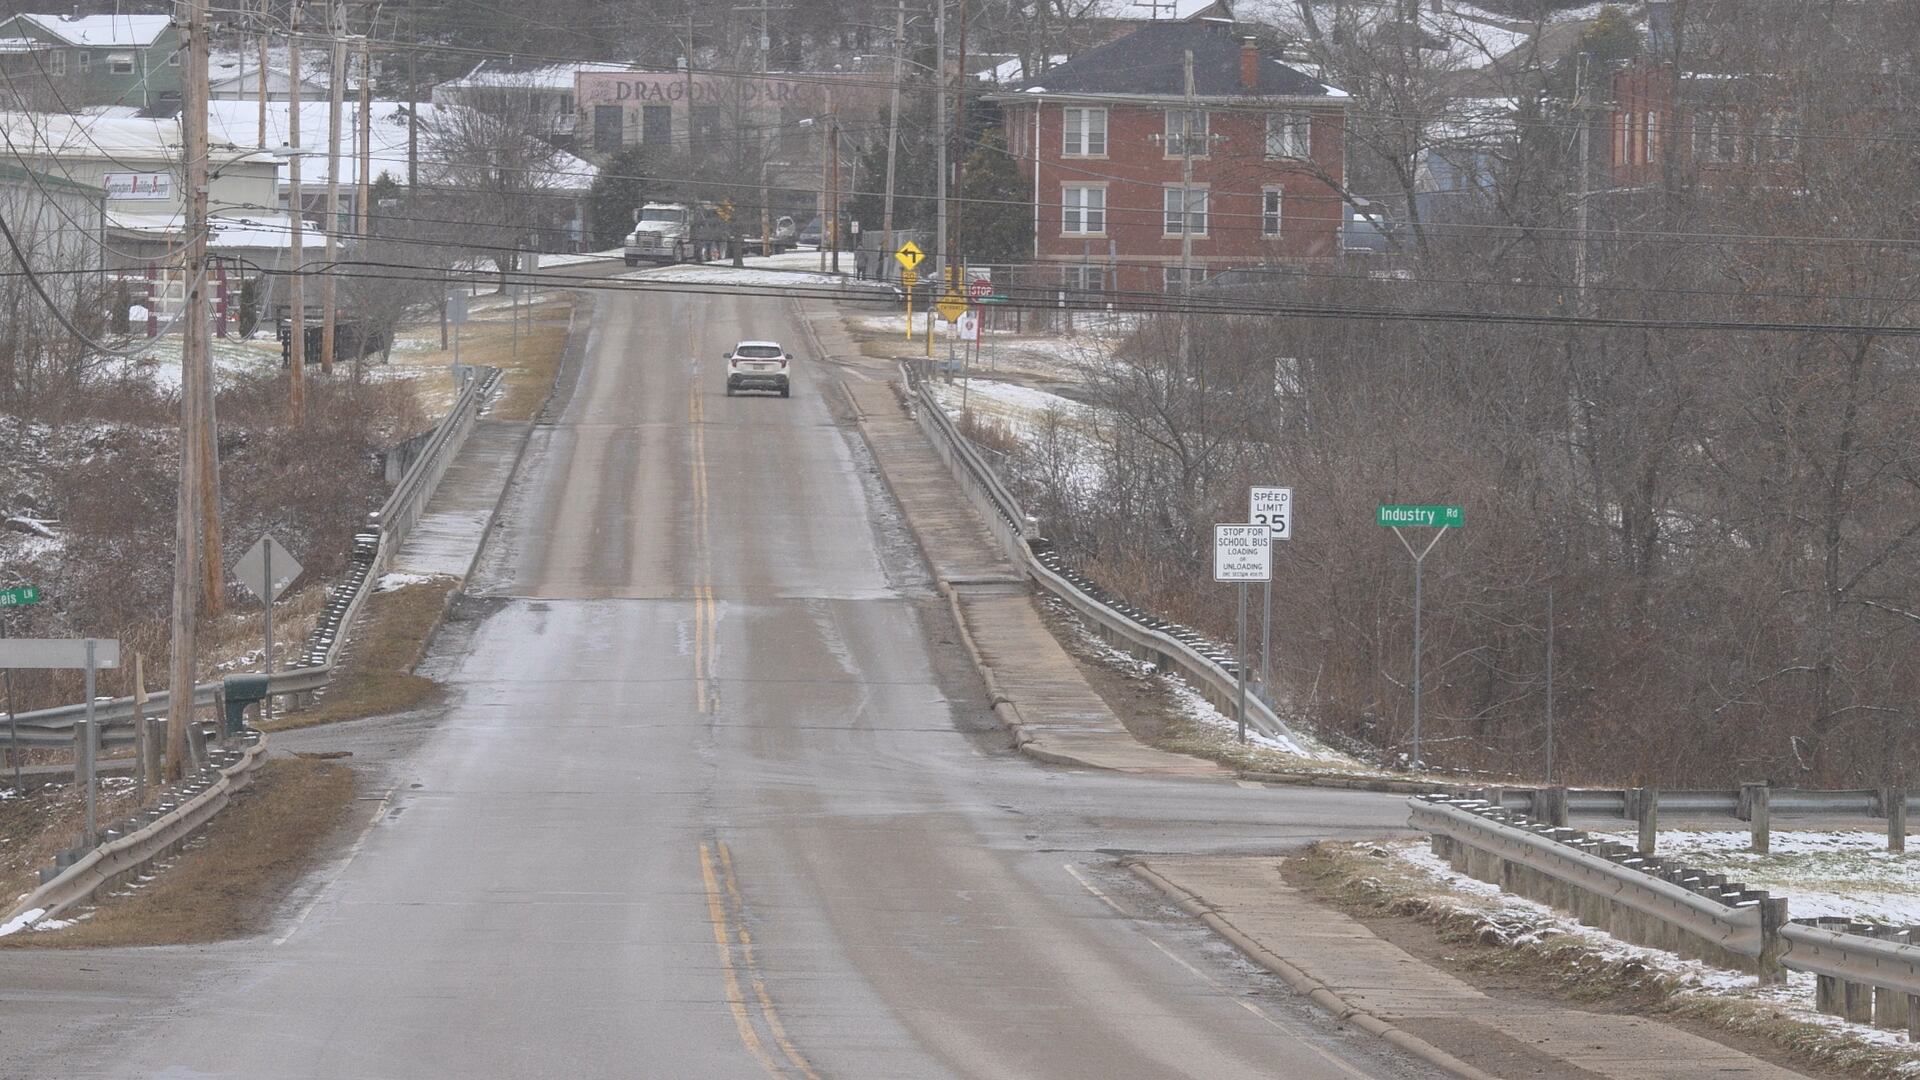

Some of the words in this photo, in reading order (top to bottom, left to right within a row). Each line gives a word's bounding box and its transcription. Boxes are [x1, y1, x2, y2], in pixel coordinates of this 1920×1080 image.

[971, 286, 992, 295] STOP
[1253, 493, 1288, 501] SPEED
[1381, 507, 1435, 525] Industry
[1446, 508, 1458, 518] Rd
[1223, 528, 1244, 536] STOP
[1247, 528, 1263, 536] FOR
[1218, 538, 1249, 547] SCHOOL
[1252, 538, 1268, 547] BUS
